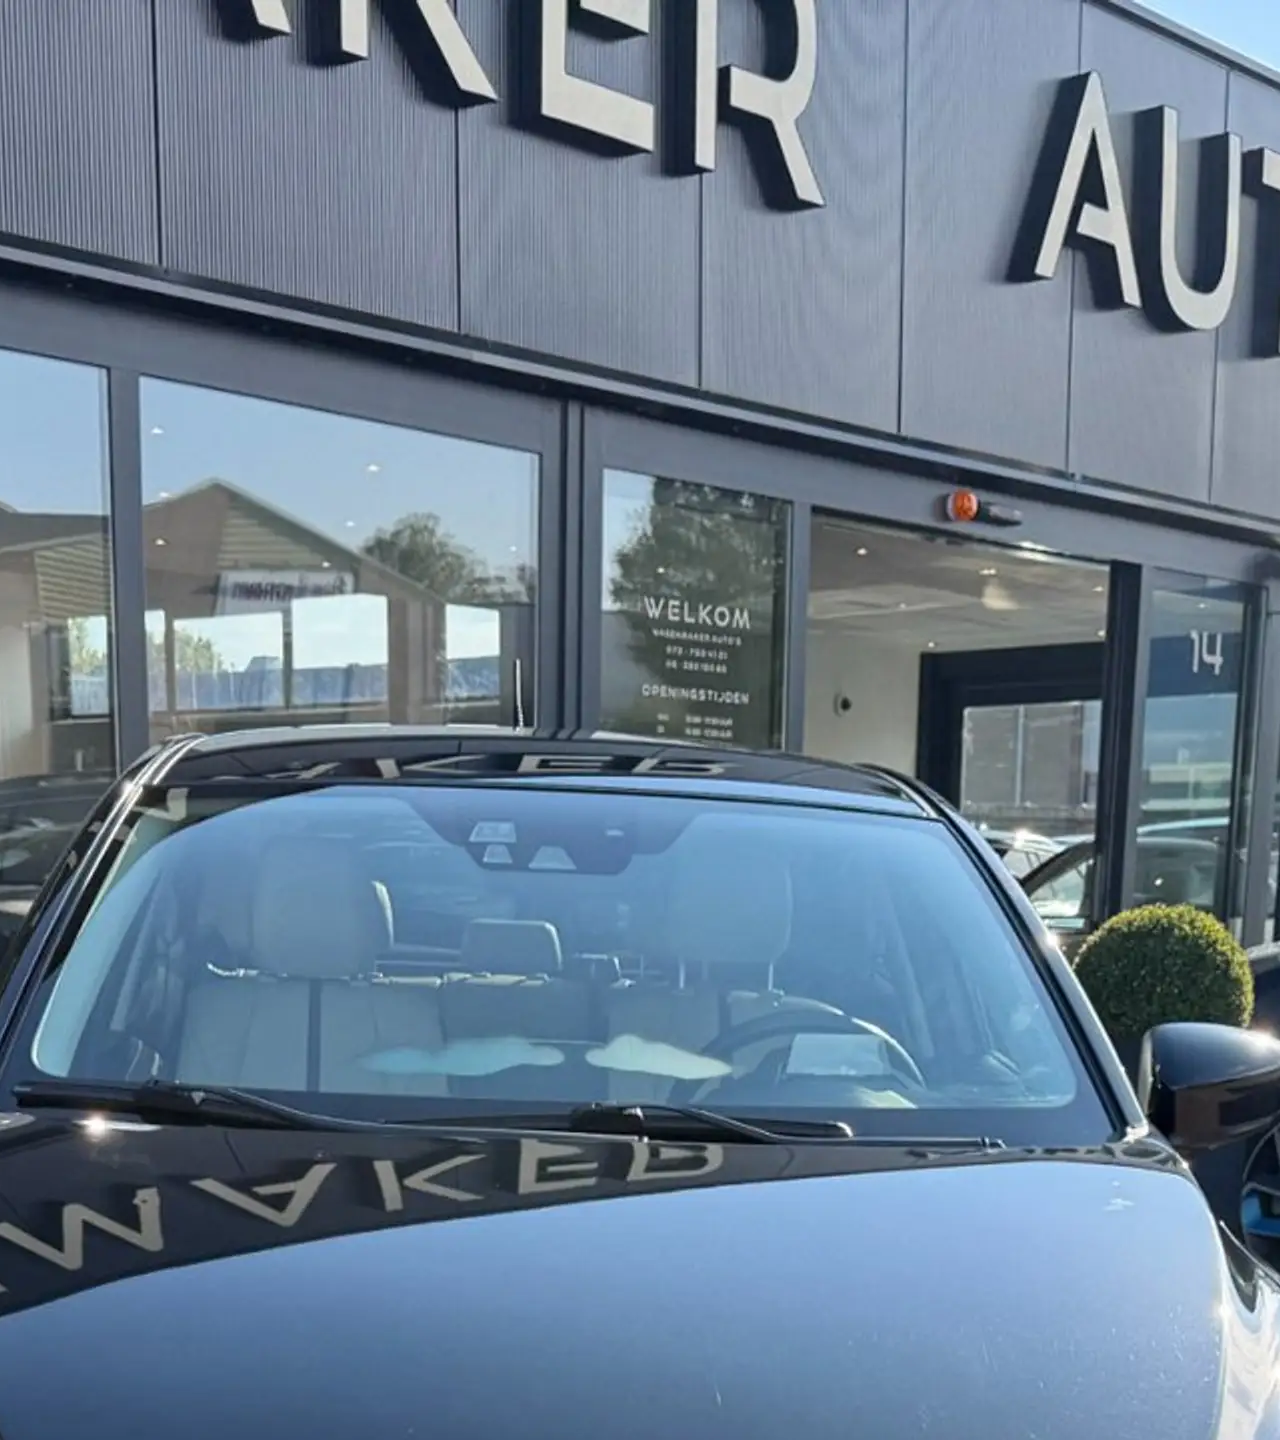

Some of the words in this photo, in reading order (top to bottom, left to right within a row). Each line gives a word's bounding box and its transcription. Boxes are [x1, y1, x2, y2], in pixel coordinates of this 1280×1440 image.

[251, 0, 824, 206] ER
[643, 595, 751, 630] WELKOM
[1189, 628, 1224, 676] 14
[642, 683, 750, 705] OPENINGSTIJDEN
